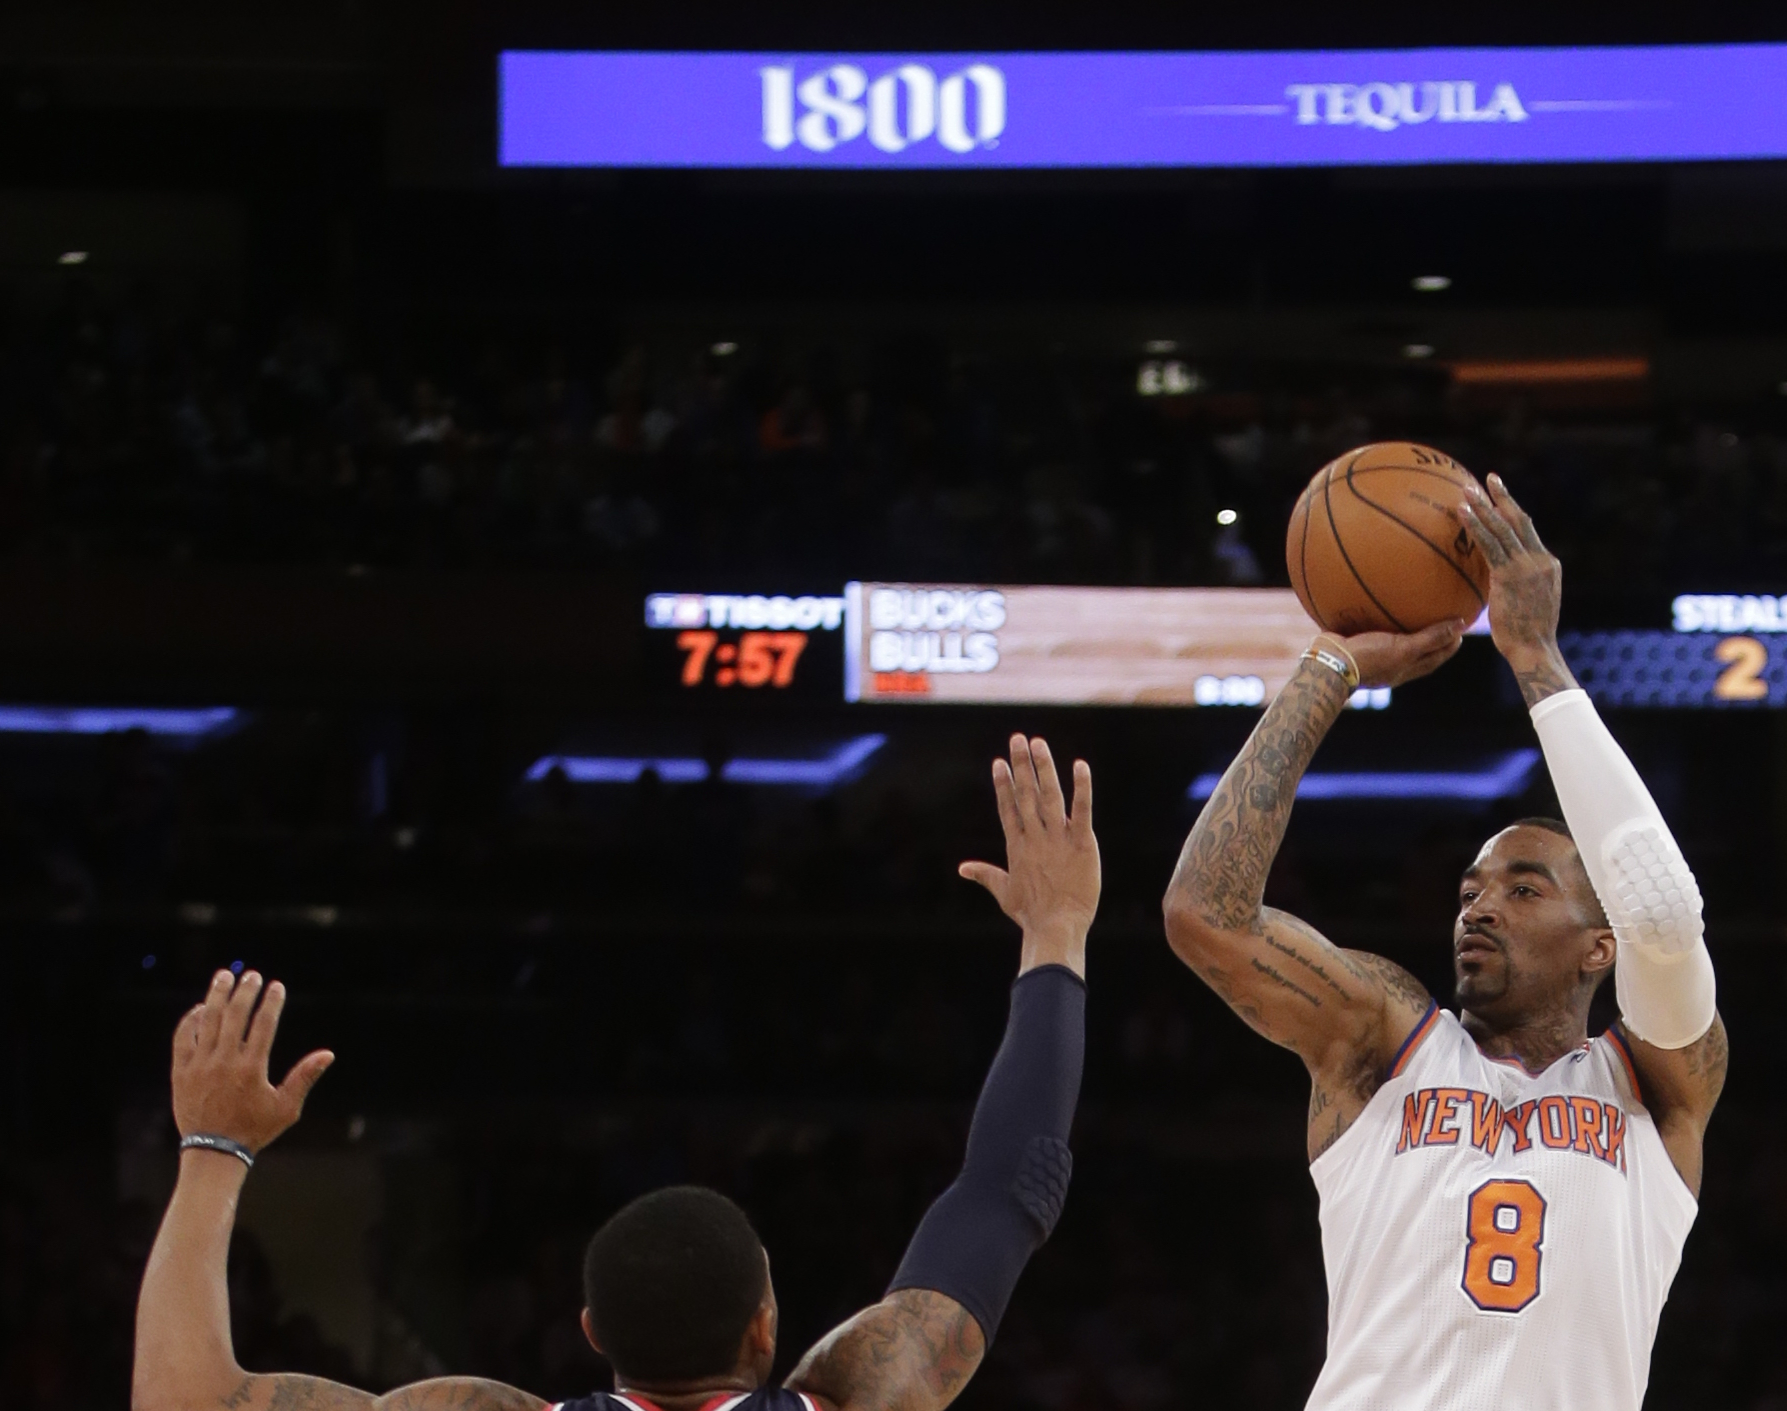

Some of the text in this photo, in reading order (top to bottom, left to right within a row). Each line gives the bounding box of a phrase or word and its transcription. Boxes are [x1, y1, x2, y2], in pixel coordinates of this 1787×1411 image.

[760, 62, 1007, 153] 1800
[1284, 80, 1530, 131] TEQUILA
[869, 588, 1005, 631] BUCKS
[1671, 593, 1787, 633] STEAL
[676, 630, 807, 687] 7:57
[869, 631, 999, 673] BULLS
[1713, 634, 1768, 701] 2
[1395, 1087, 1505, 1157] NEW
[1503, 1095, 1627, 1180] YORK
[1460, 1178, 1548, 1314] 8
